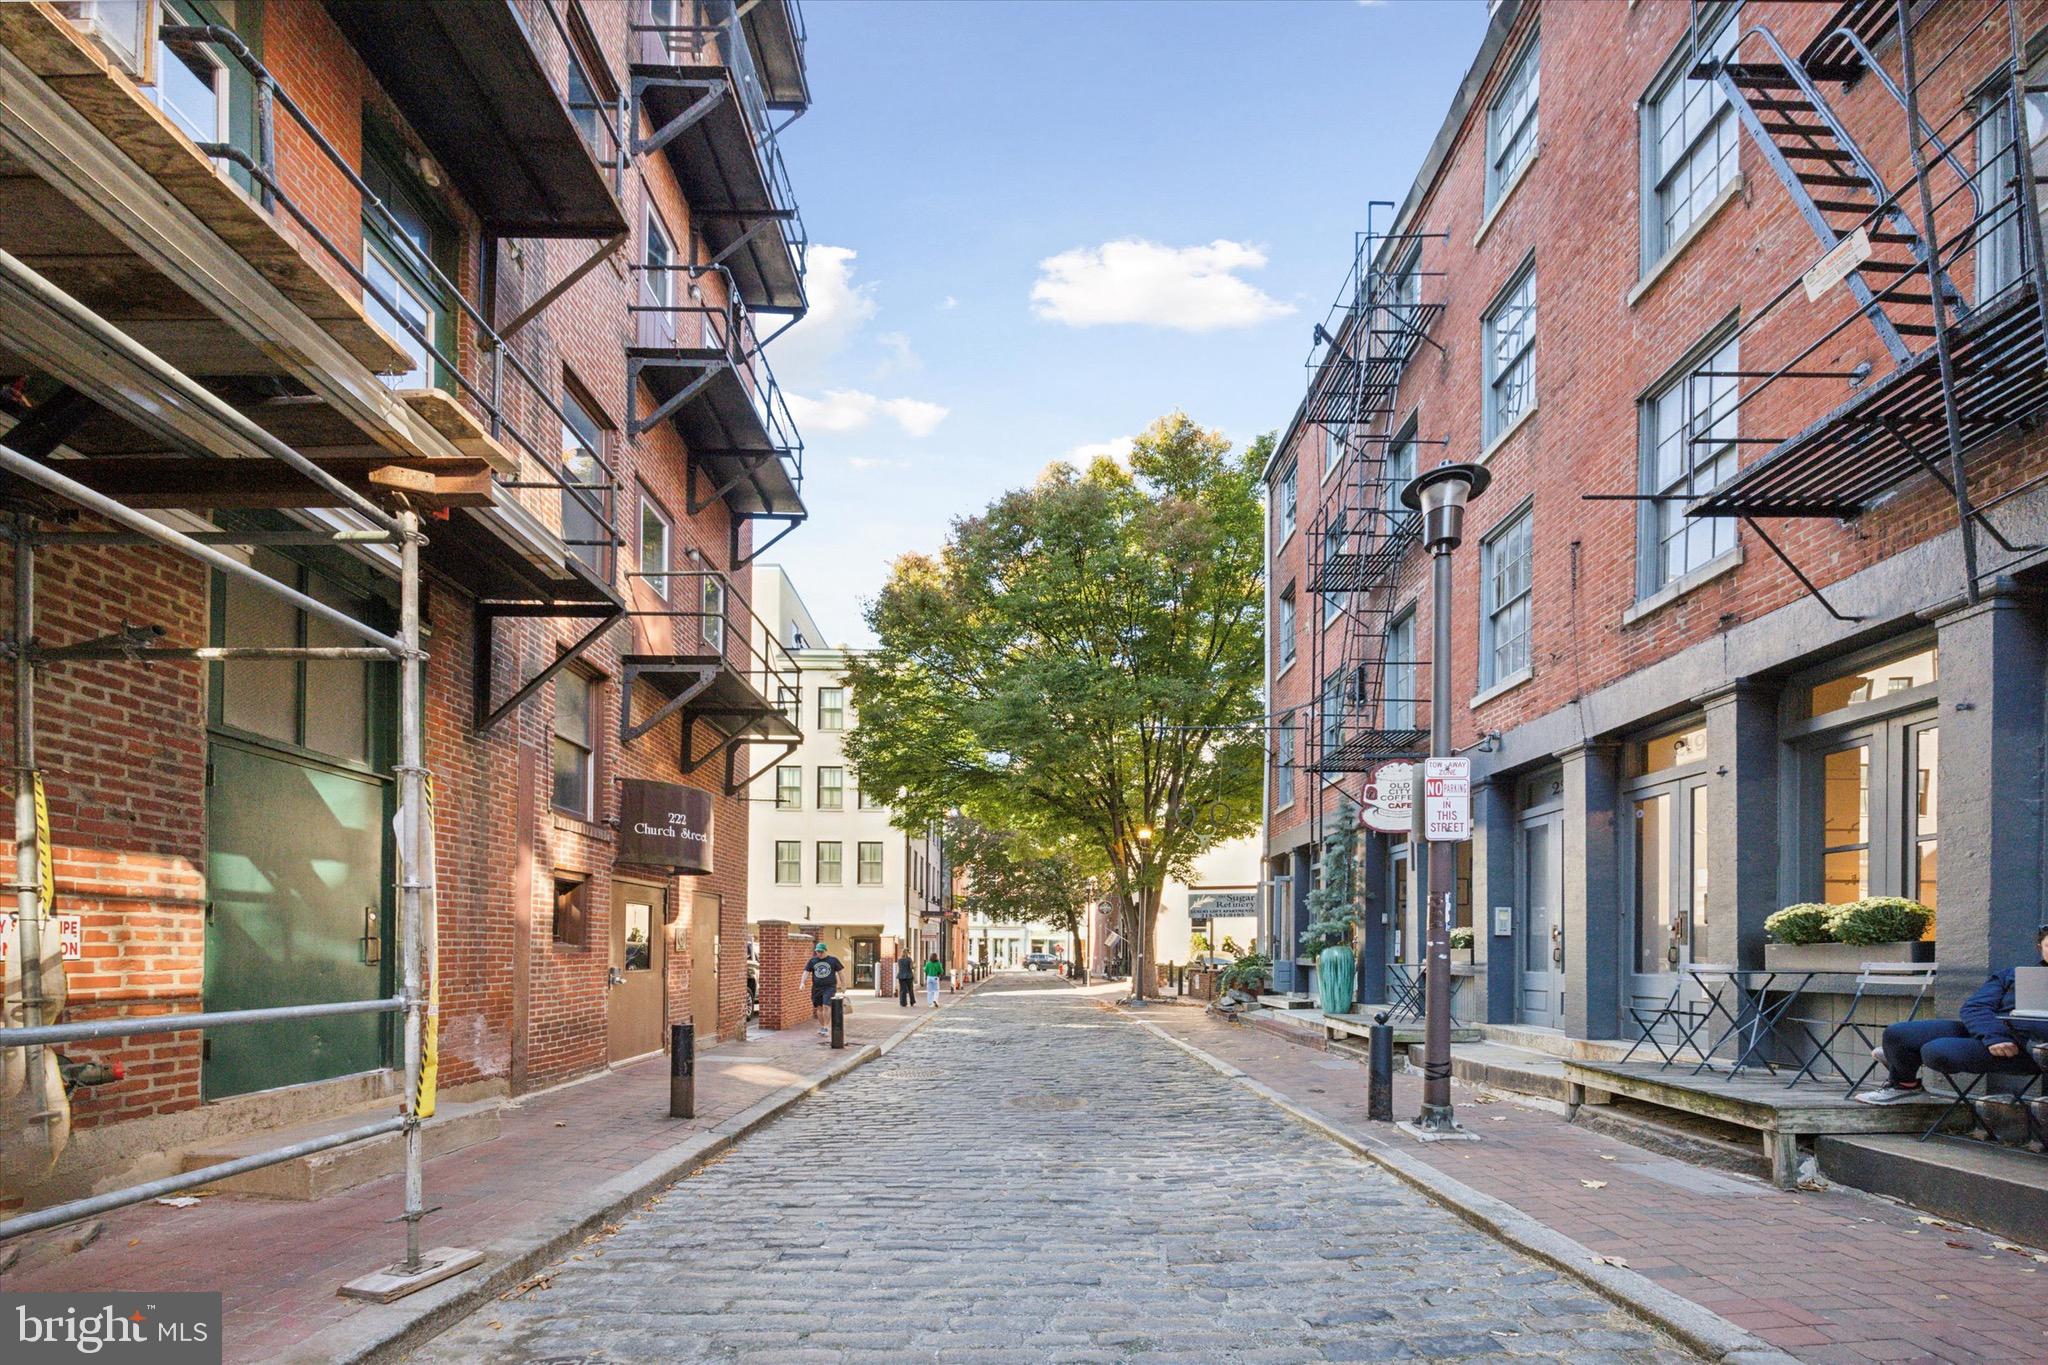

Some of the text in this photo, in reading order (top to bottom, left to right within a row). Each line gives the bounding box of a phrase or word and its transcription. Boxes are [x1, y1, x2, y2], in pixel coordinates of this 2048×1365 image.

[1427, 781, 1467, 796] NO PARKING
[1442, 800, 1451, 809] IN
[667, 812, 687, 825] 222
[1436, 810, 1458, 821] THIS
[634, 822, 676, 837] Church
[1430, 822, 1465, 833] STREET
[1226, 894, 1255, 902] Sugar
[1216, 901, 1255, 909] Refinery
